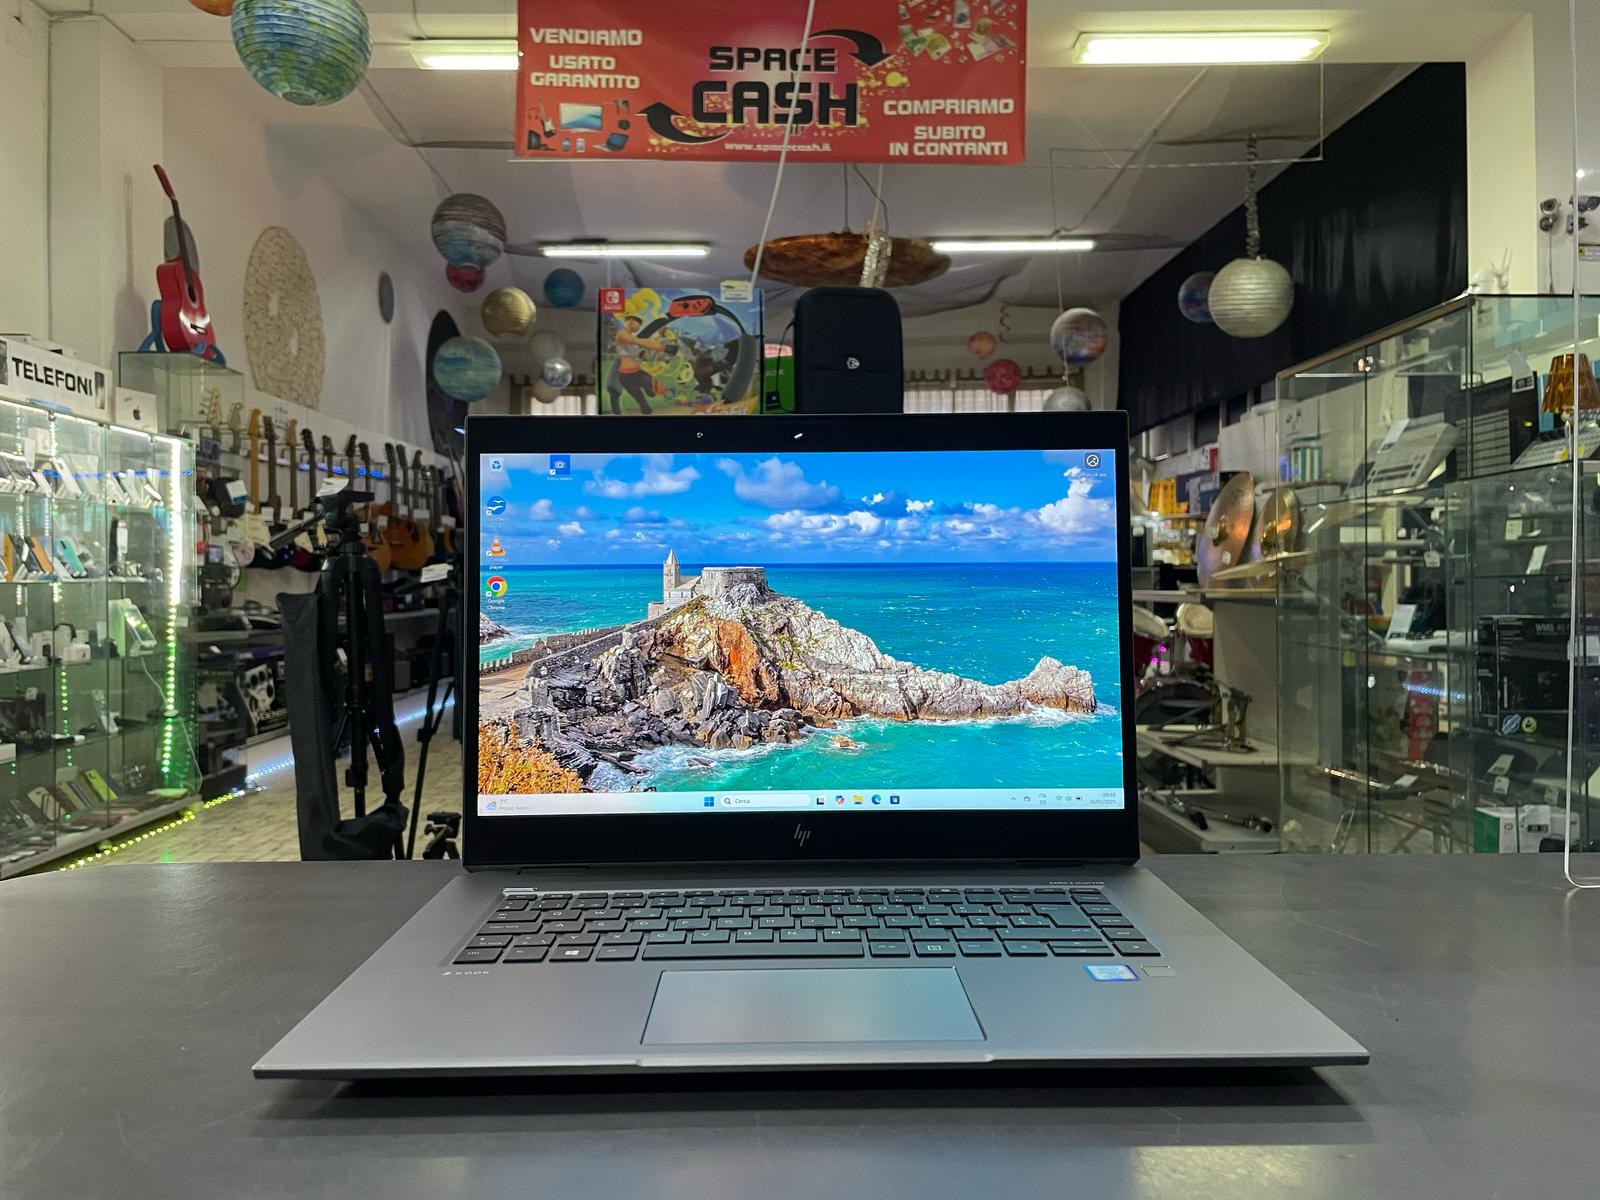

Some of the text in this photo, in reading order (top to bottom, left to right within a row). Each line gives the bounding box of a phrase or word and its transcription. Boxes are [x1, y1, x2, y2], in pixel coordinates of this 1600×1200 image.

[529, 27, 643, 46] VENDIAMO
[549, 55, 616, 70] USATO
[709, 46, 838, 72] SPACE
[530, 72, 641, 89] GARANTITO
[692, 80, 857, 126] CASH
[883, 98, 1015, 116] COMPRIAMO
[914, 126, 986, 140] SUBITO
[724, 143, 832, 152] www.spaccash.it
[889, 141, 1008, 156] IN CONTANTI
[12, 357, 93, 396] TELEFONI
